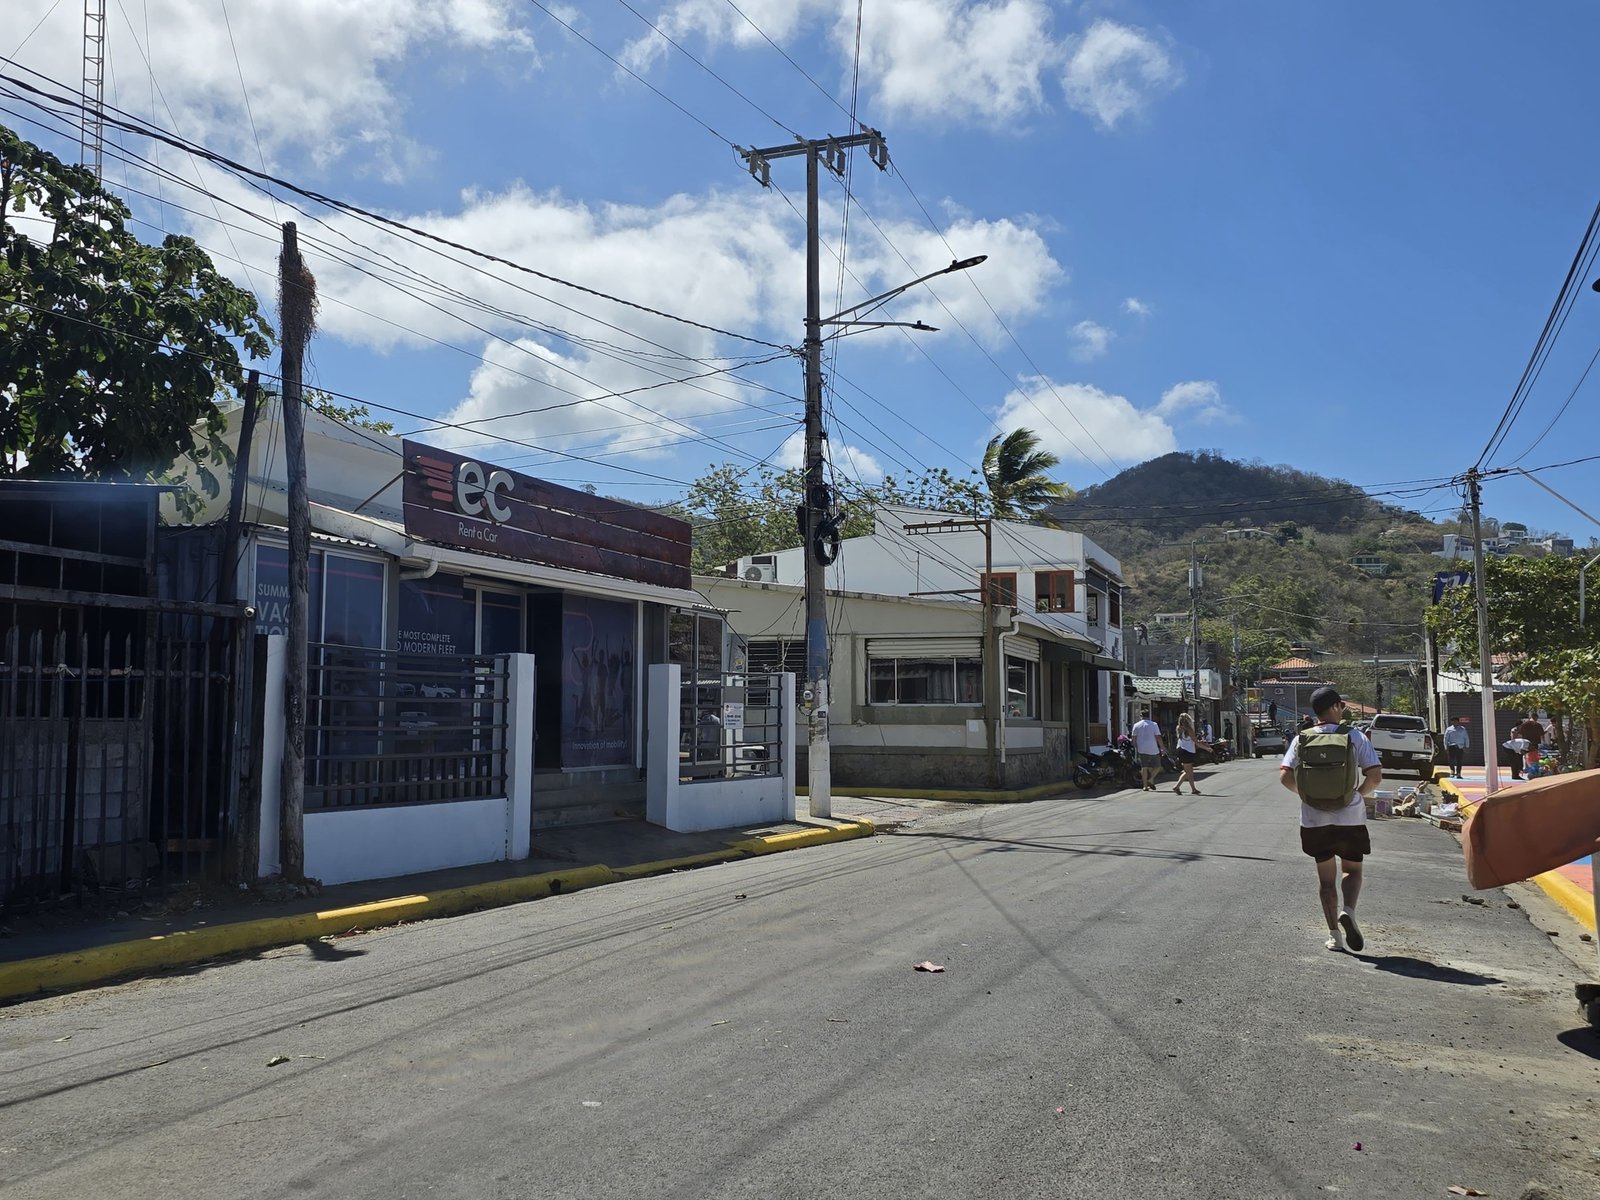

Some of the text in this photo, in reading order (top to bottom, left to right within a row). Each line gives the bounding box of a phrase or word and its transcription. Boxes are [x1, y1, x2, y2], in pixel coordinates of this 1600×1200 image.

[458, 521, 498, 543] Rent a Car
[403, 630, 420, 640] MOST
[421, 632, 451, 643] COMPLETE
[403, 641, 437, 654] MODERN
[438, 644, 456, 655] FLEET
